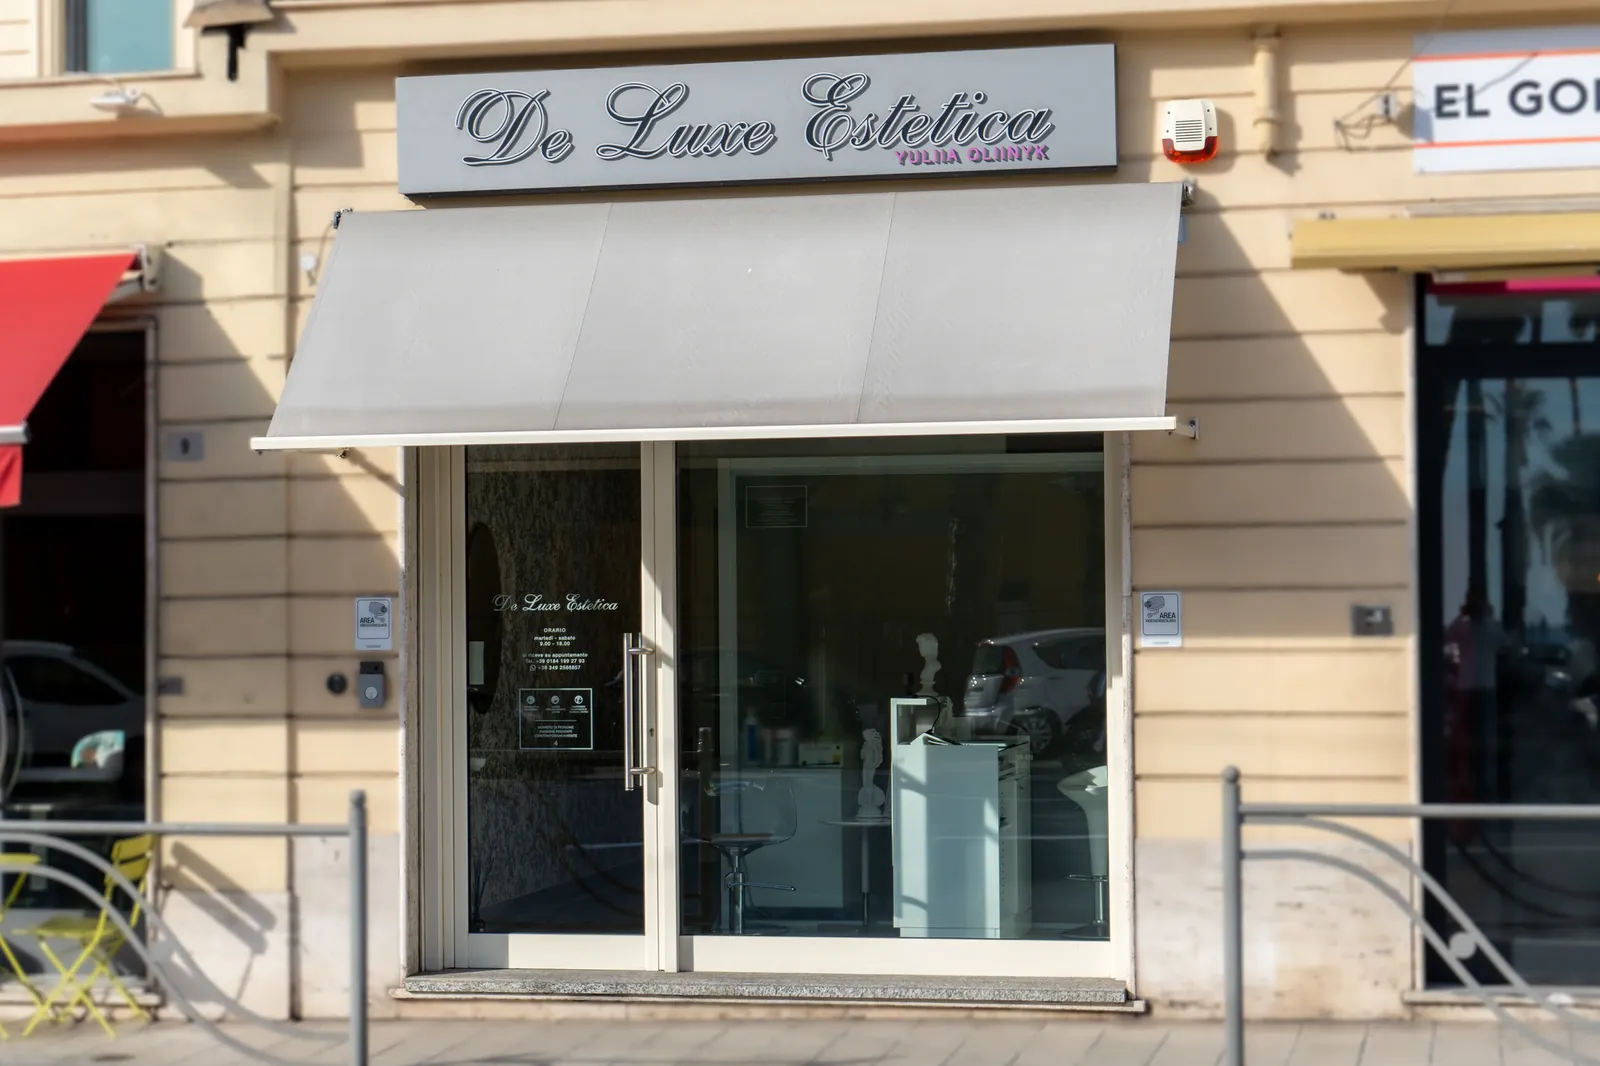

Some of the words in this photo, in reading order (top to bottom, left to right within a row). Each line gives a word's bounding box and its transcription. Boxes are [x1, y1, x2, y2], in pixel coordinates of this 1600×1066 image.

[1434, 83, 1490, 119] EL
[455, 87, 574, 166] De
[595, 81, 778, 160] Luxe
[801, 71, 1055, 161] Estetica
[894, 148, 962, 166] YULIIA
[967, 144, 1050, 163] OLIINYK
[492, 594, 517, 611] De
[522, 593, 560, 611] Luxe
[566, 593, 618, 612] Estetica
